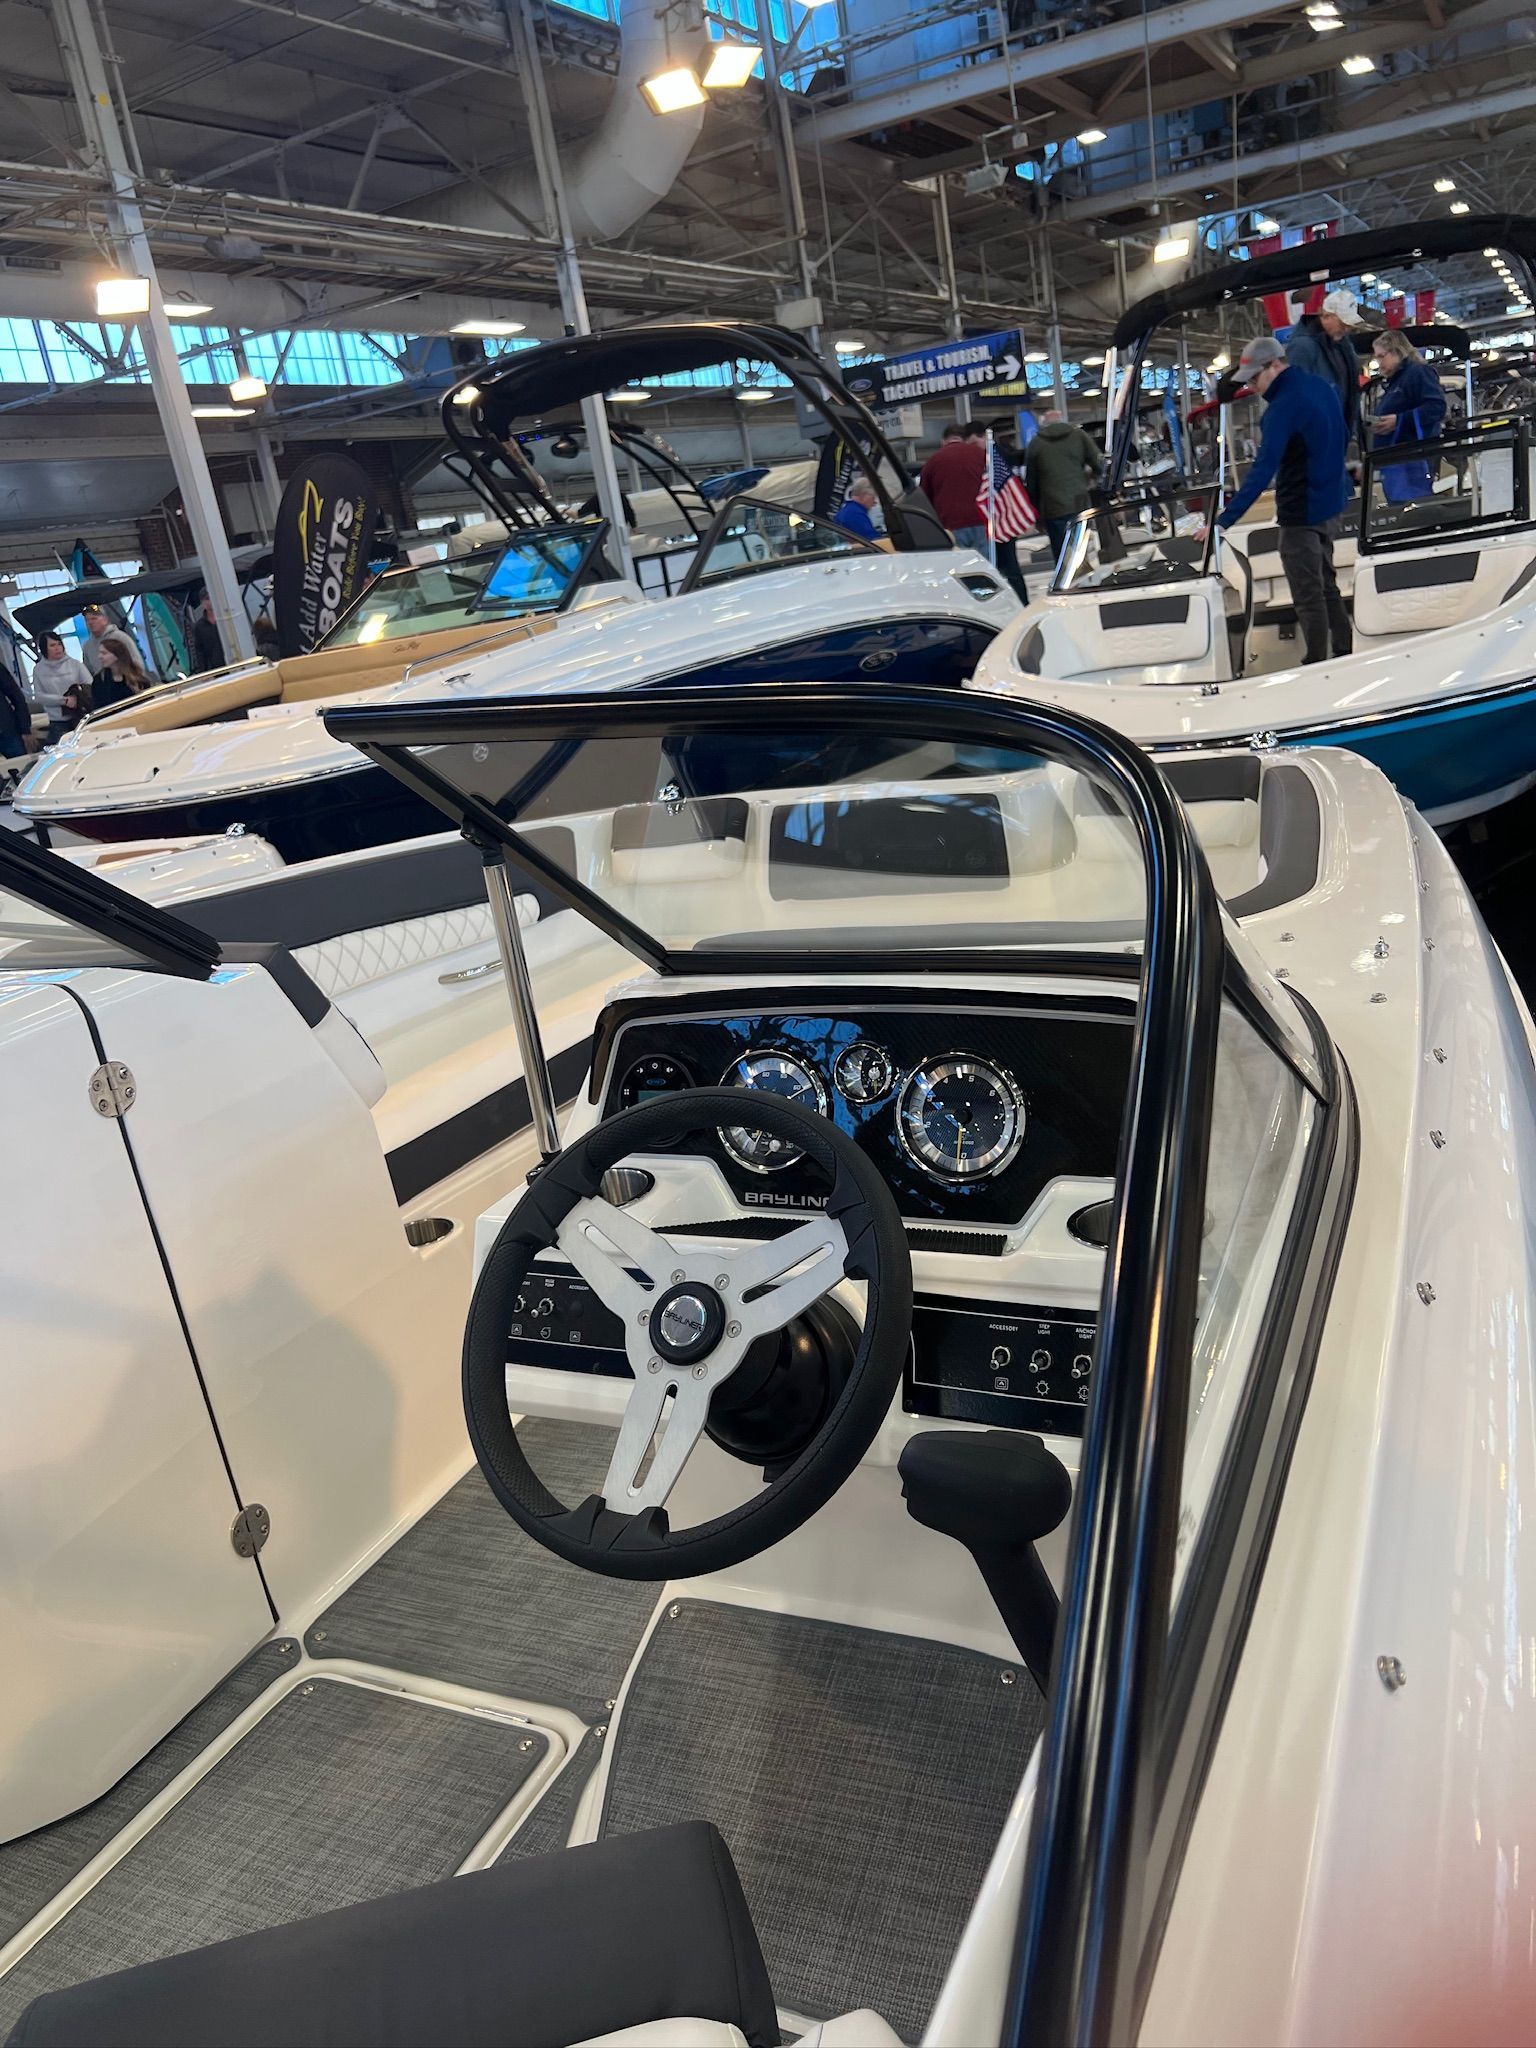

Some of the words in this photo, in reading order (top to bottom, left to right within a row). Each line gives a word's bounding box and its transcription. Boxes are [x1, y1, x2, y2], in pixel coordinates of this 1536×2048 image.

[883, 360, 925, 382] TRAVEL
[926, 359, 936, 373] &
[957, 373, 967, 388] &
[303, 532, 327, 593] Water
[318, 497, 354, 635] BOATS
[299, 596, 318, 643] Add
[988, 1323, 1018, 1332] ACCESSORY
